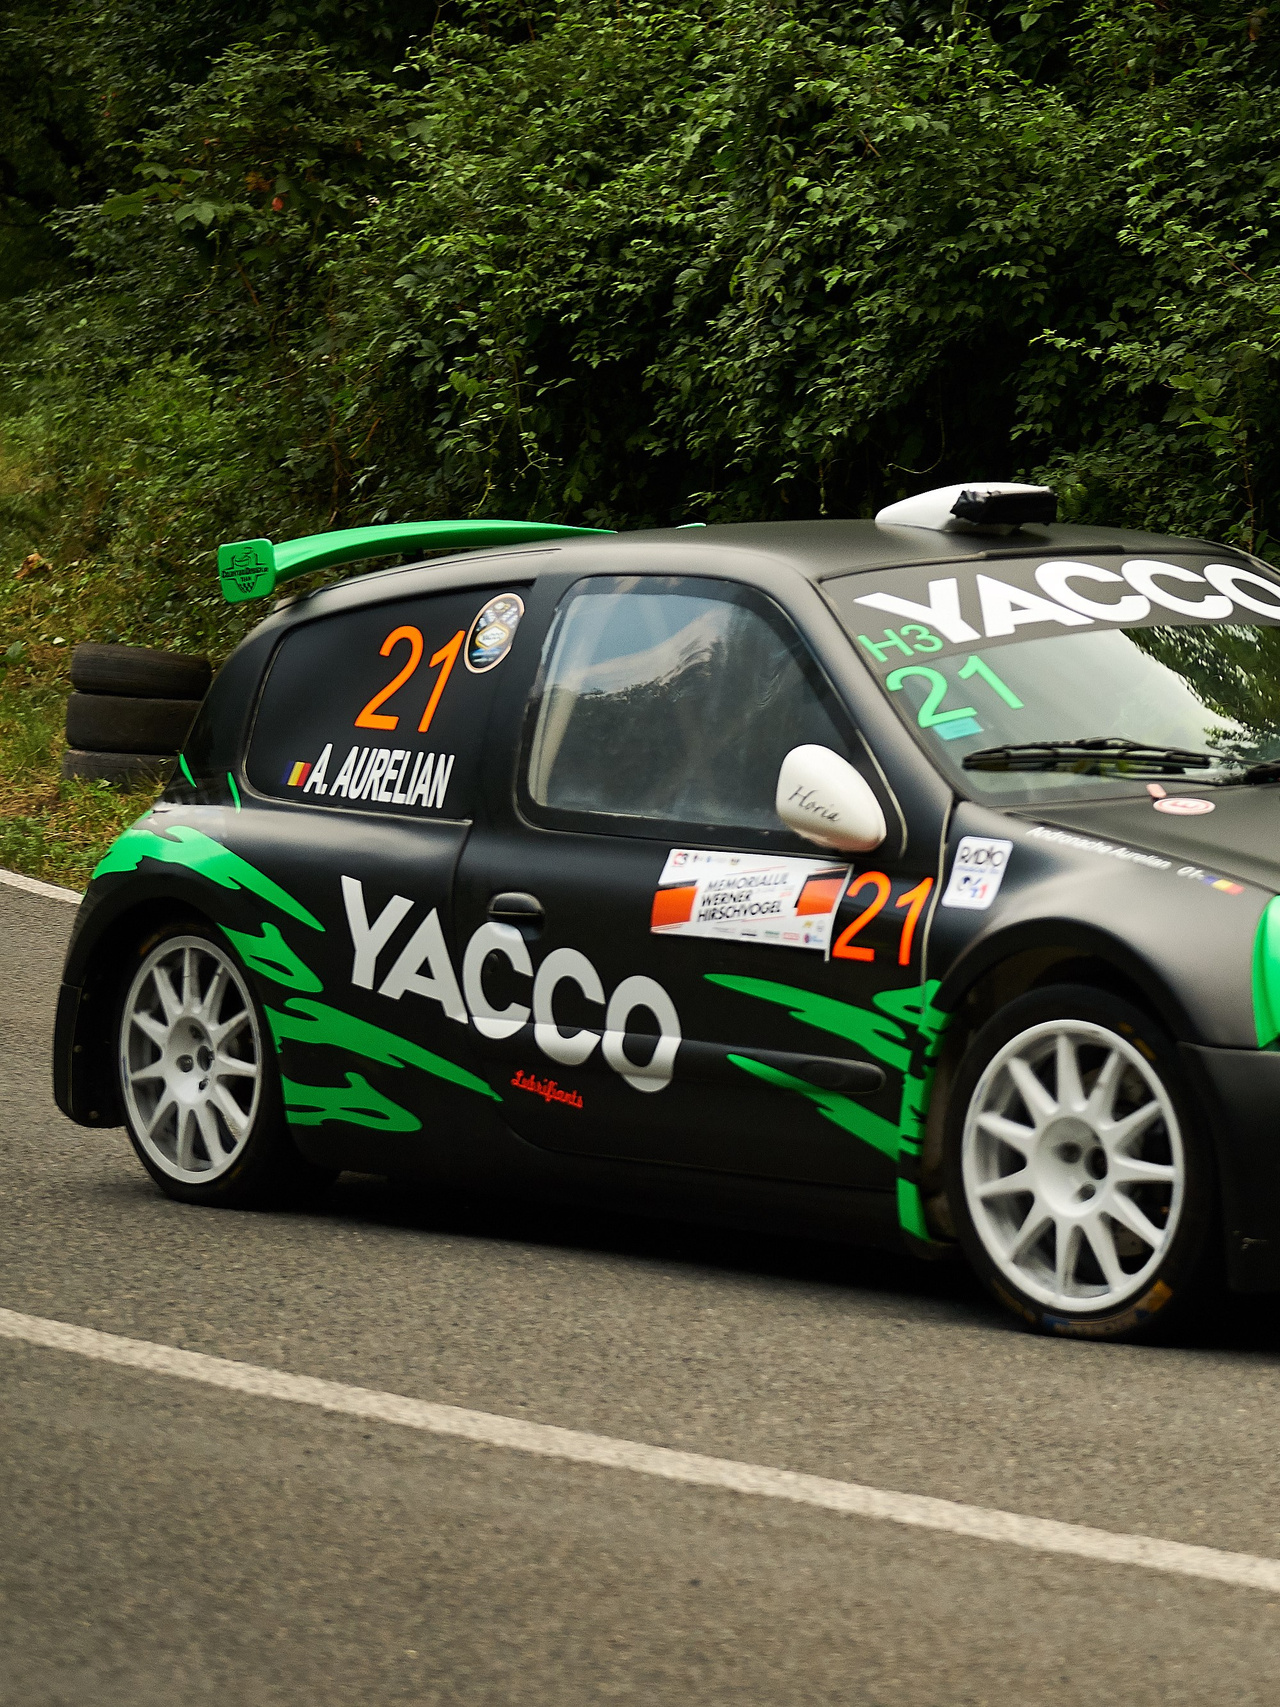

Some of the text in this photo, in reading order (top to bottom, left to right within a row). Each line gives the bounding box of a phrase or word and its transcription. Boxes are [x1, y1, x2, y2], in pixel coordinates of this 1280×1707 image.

[857, 624, 944, 663] H3
[354, 625, 466, 733] 21
[885, 655, 1024, 729] 21
[303, 743, 455, 809] A. AURELIAN
[788, 785, 840, 822] Horia
[1111, 847, 1172, 870] Aurelian
[701, 889, 754, 908] WERNER
[704, 872, 790, 893] MEMORIALUL
[697, 900, 783, 923] HIRSCHVOGEL
[831, 870, 934, 966] 21
[341, 875, 682, 1093] YACCO
